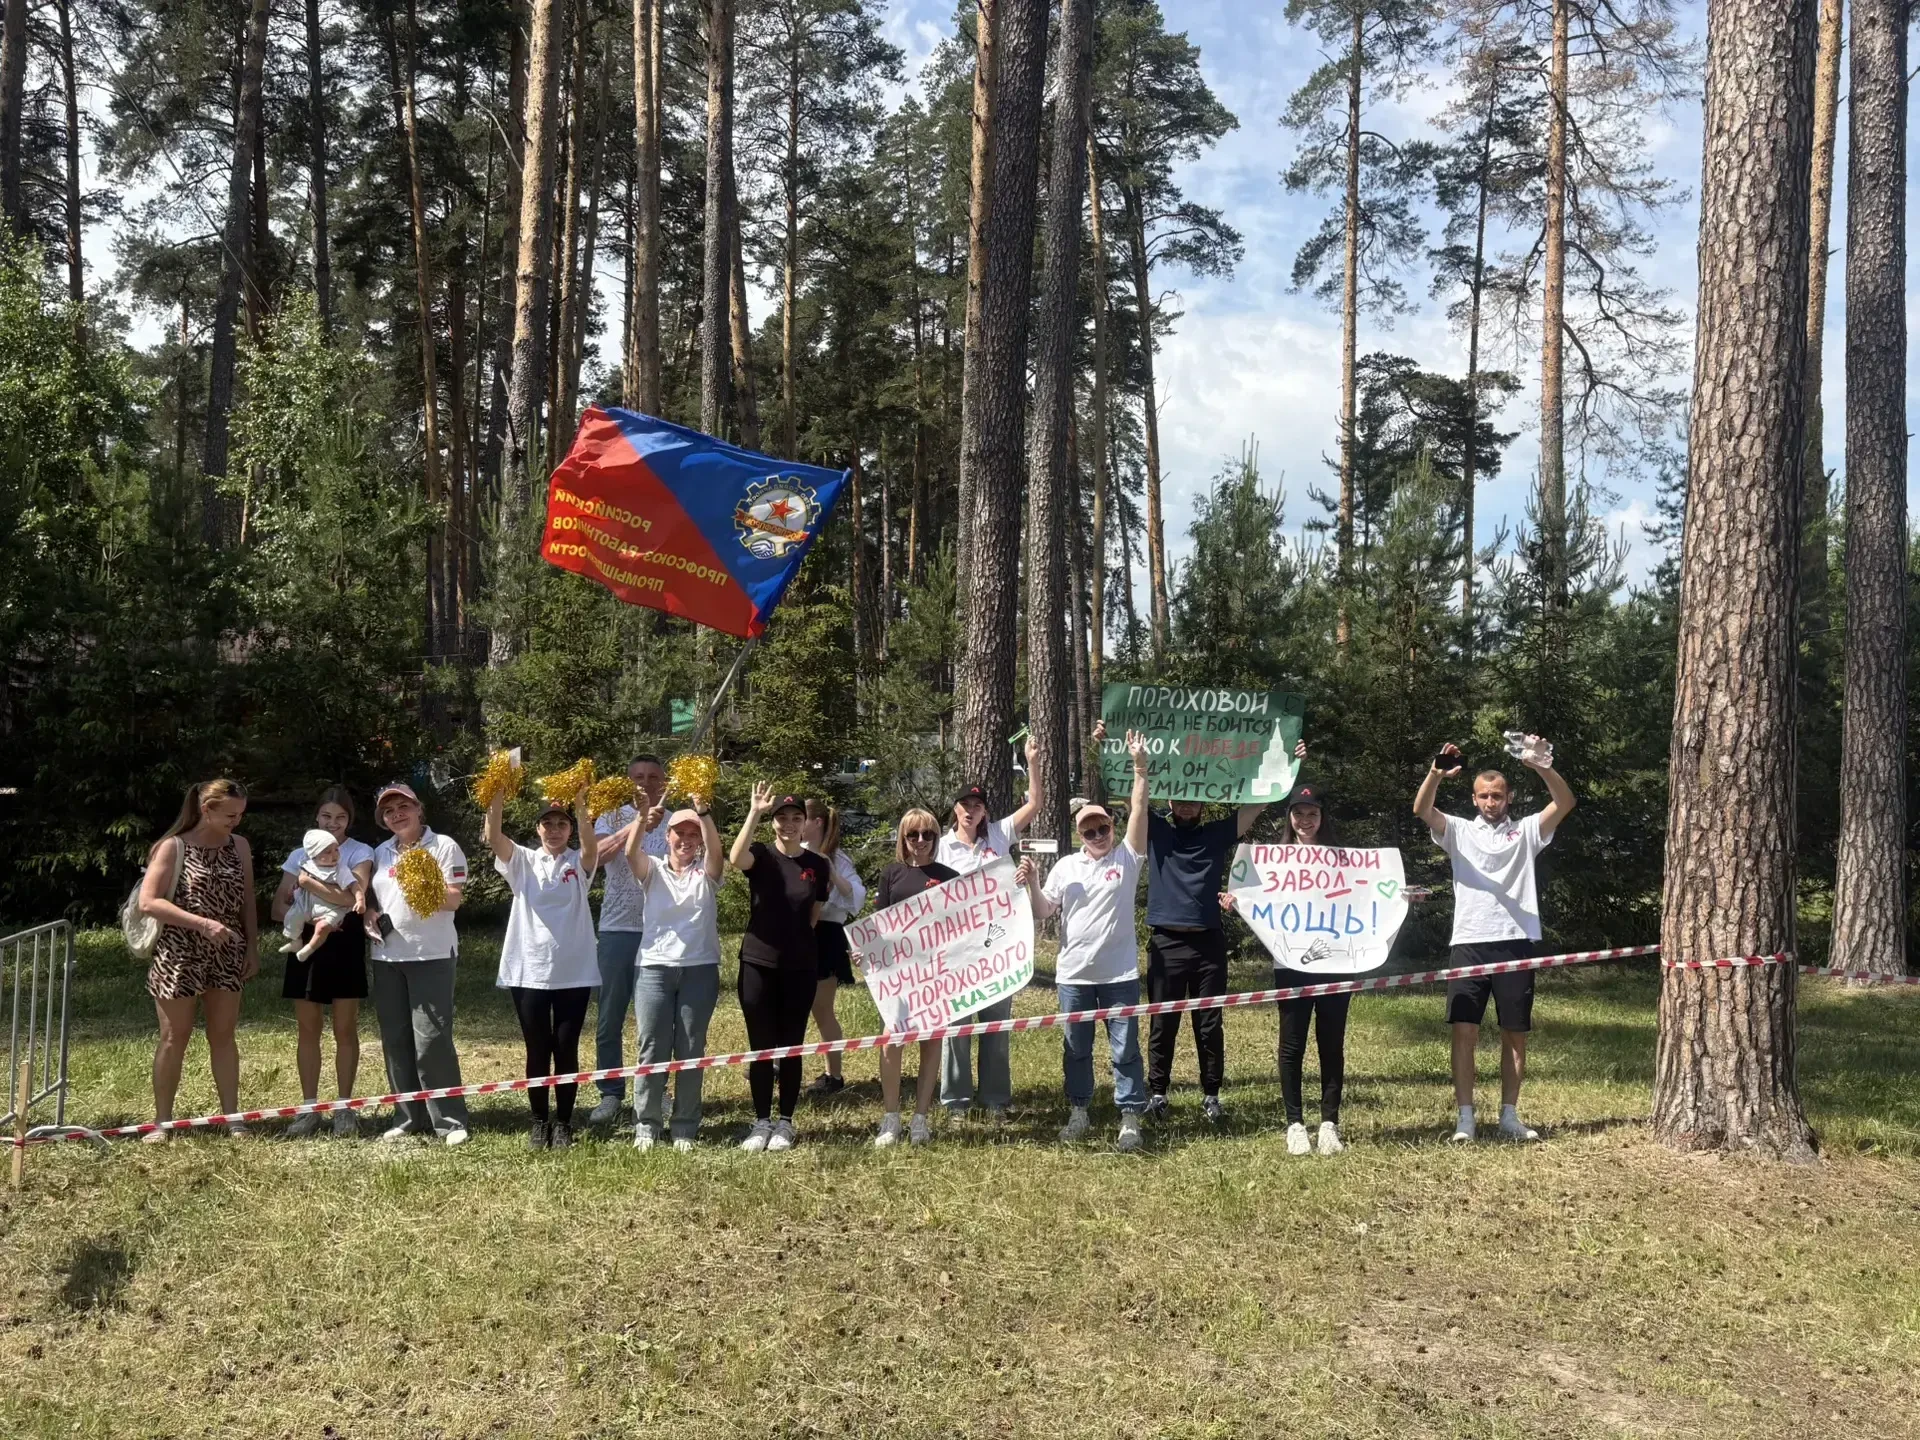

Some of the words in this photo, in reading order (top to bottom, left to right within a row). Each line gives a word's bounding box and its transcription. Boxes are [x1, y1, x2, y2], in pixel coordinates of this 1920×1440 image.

[1127, 686, 1270, 715] ПОРОХОВОЙ
[1105, 711, 1176, 731] НИКОГДА
[1184, 715, 1202, 730] НЕ
[1206, 715, 1273, 735] БОИТСЯ
[1168, 738, 1181, 755] К
[1103, 758, 1172, 777] ВСЕДА
[1183, 760, 1209, 778] ОН
[1254, 845, 1380, 869] ПОРОХОВОЙ
[940, 868, 998, 910] ХОТЬ
[868, 936, 913, 974] ВСЮ
[918, 891, 1017, 951] ПЛАНЕТУ,
[879, 950, 949, 1001] ЛУЧШЕ
[908, 940, 1027, 1012] ПОРОХОВОГО
